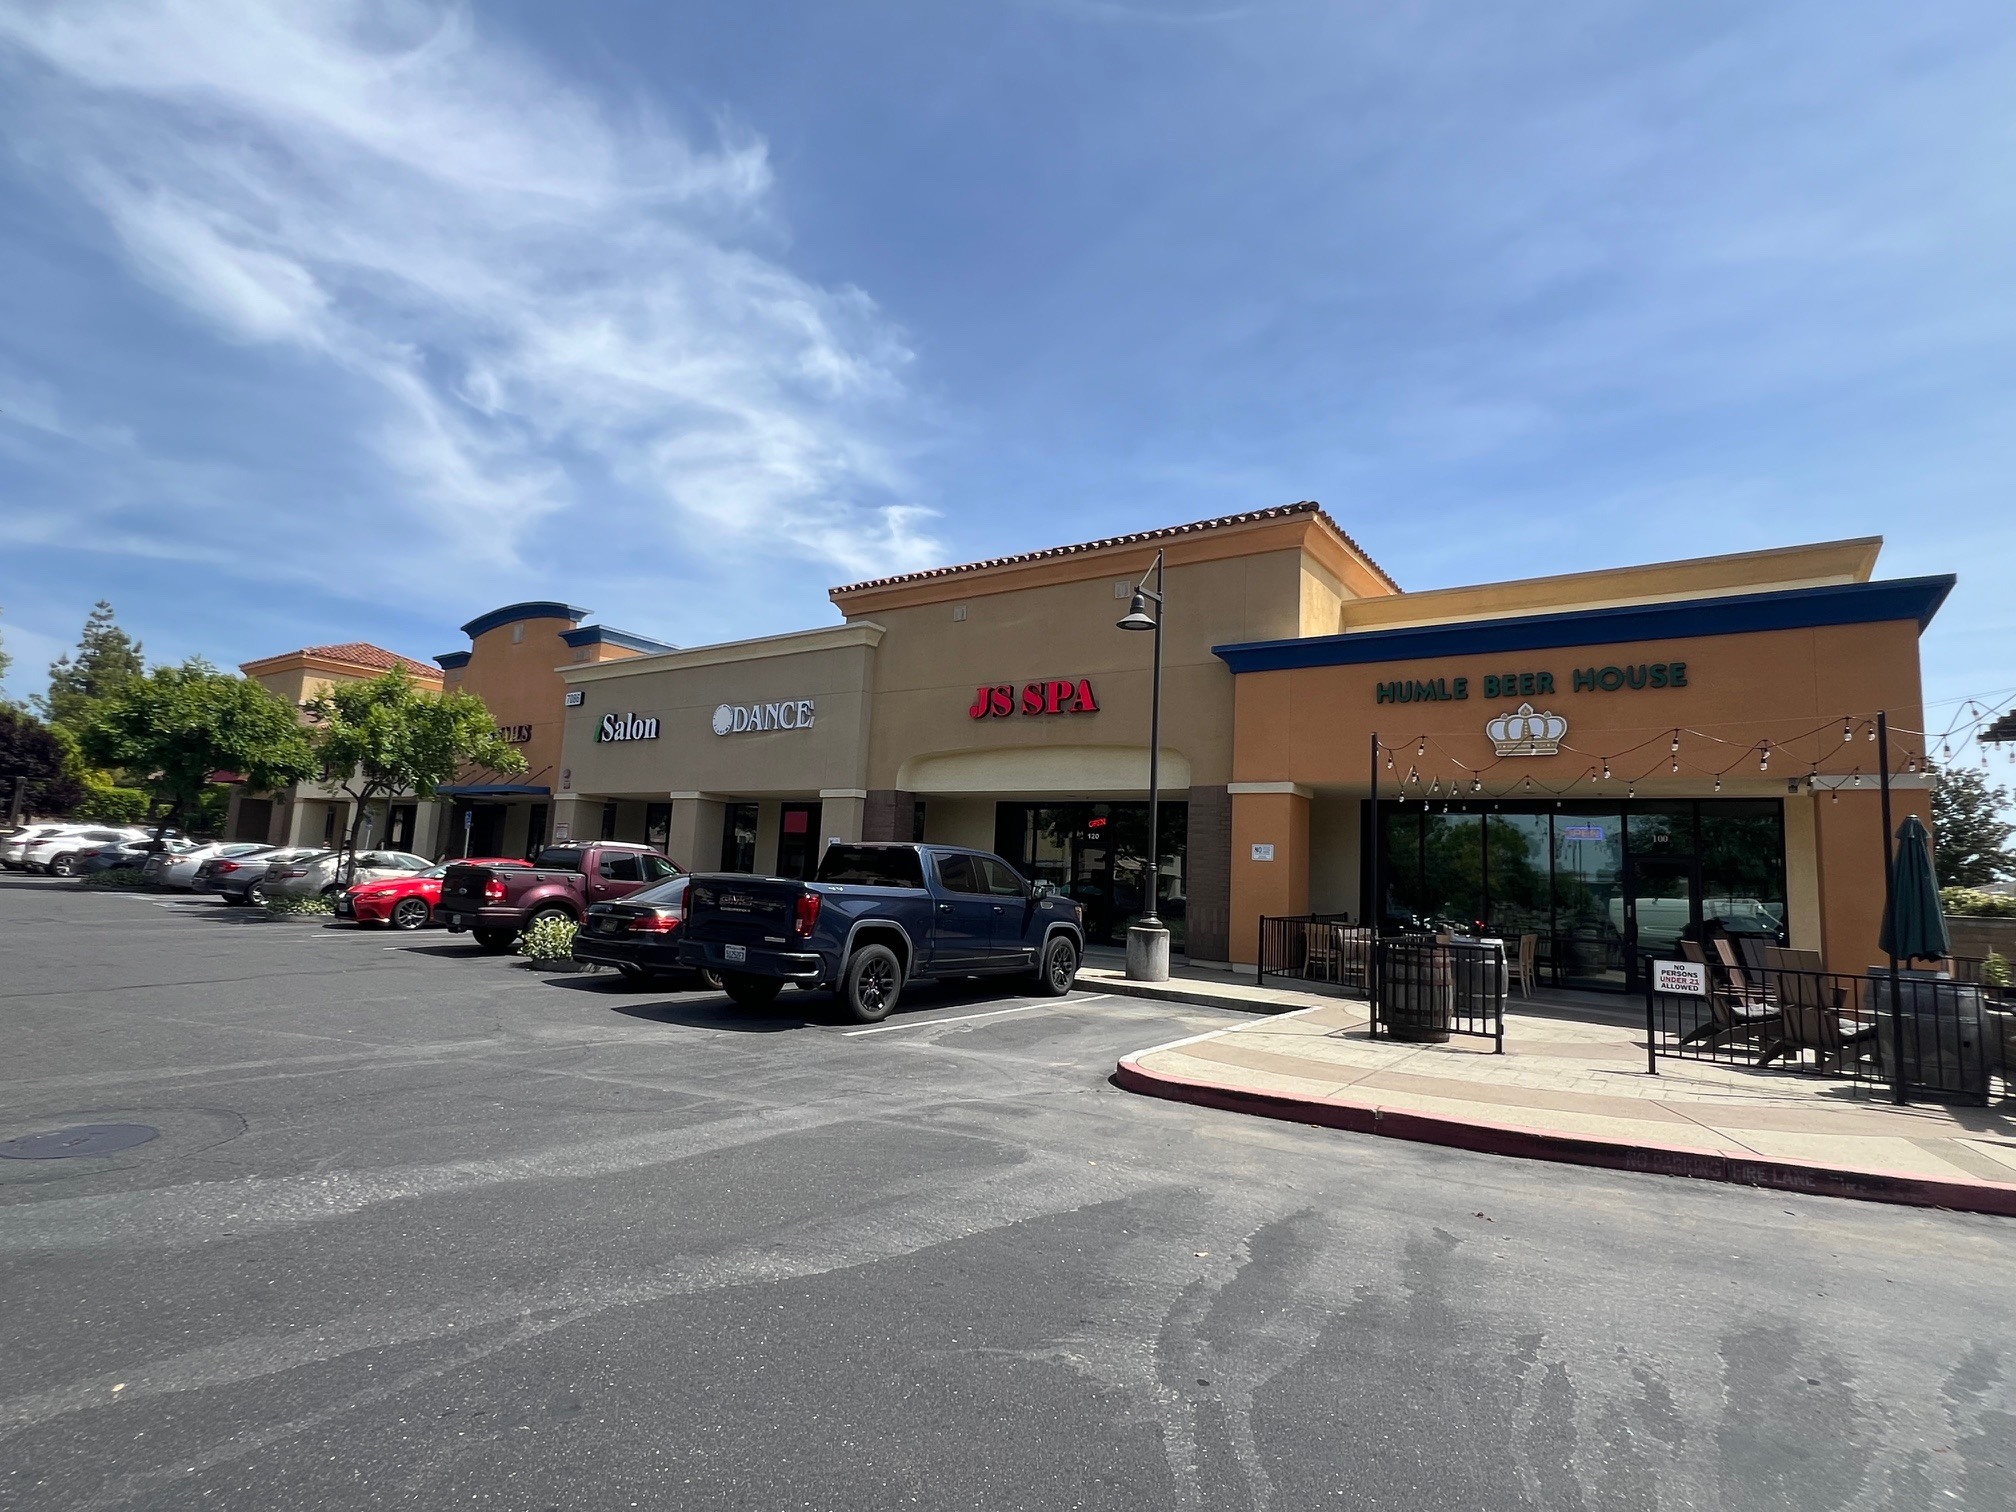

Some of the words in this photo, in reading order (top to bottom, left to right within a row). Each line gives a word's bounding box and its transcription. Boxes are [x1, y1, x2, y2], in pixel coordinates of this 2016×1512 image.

[1376, 677, 1468, 704] HUMLE
[1483, 671, 1555, 699] BEER
[1572, 662, 1688, 694] HOUSE
[969, 685, 1014, 719] JS
[1021, 679, 1099, 716] SPA
[732, 700, 815, 733] DANCE
[601, 712, 660, 742] Salon
[1653, 834, 1668, 843] 100
[1660, 976, 1687, 984] UNDER
[1689, 978, 1700, 986] 21
[1661, 969, 1698, 979] PERSONS
[1660, 982, 1699, 992] ALLOWED
